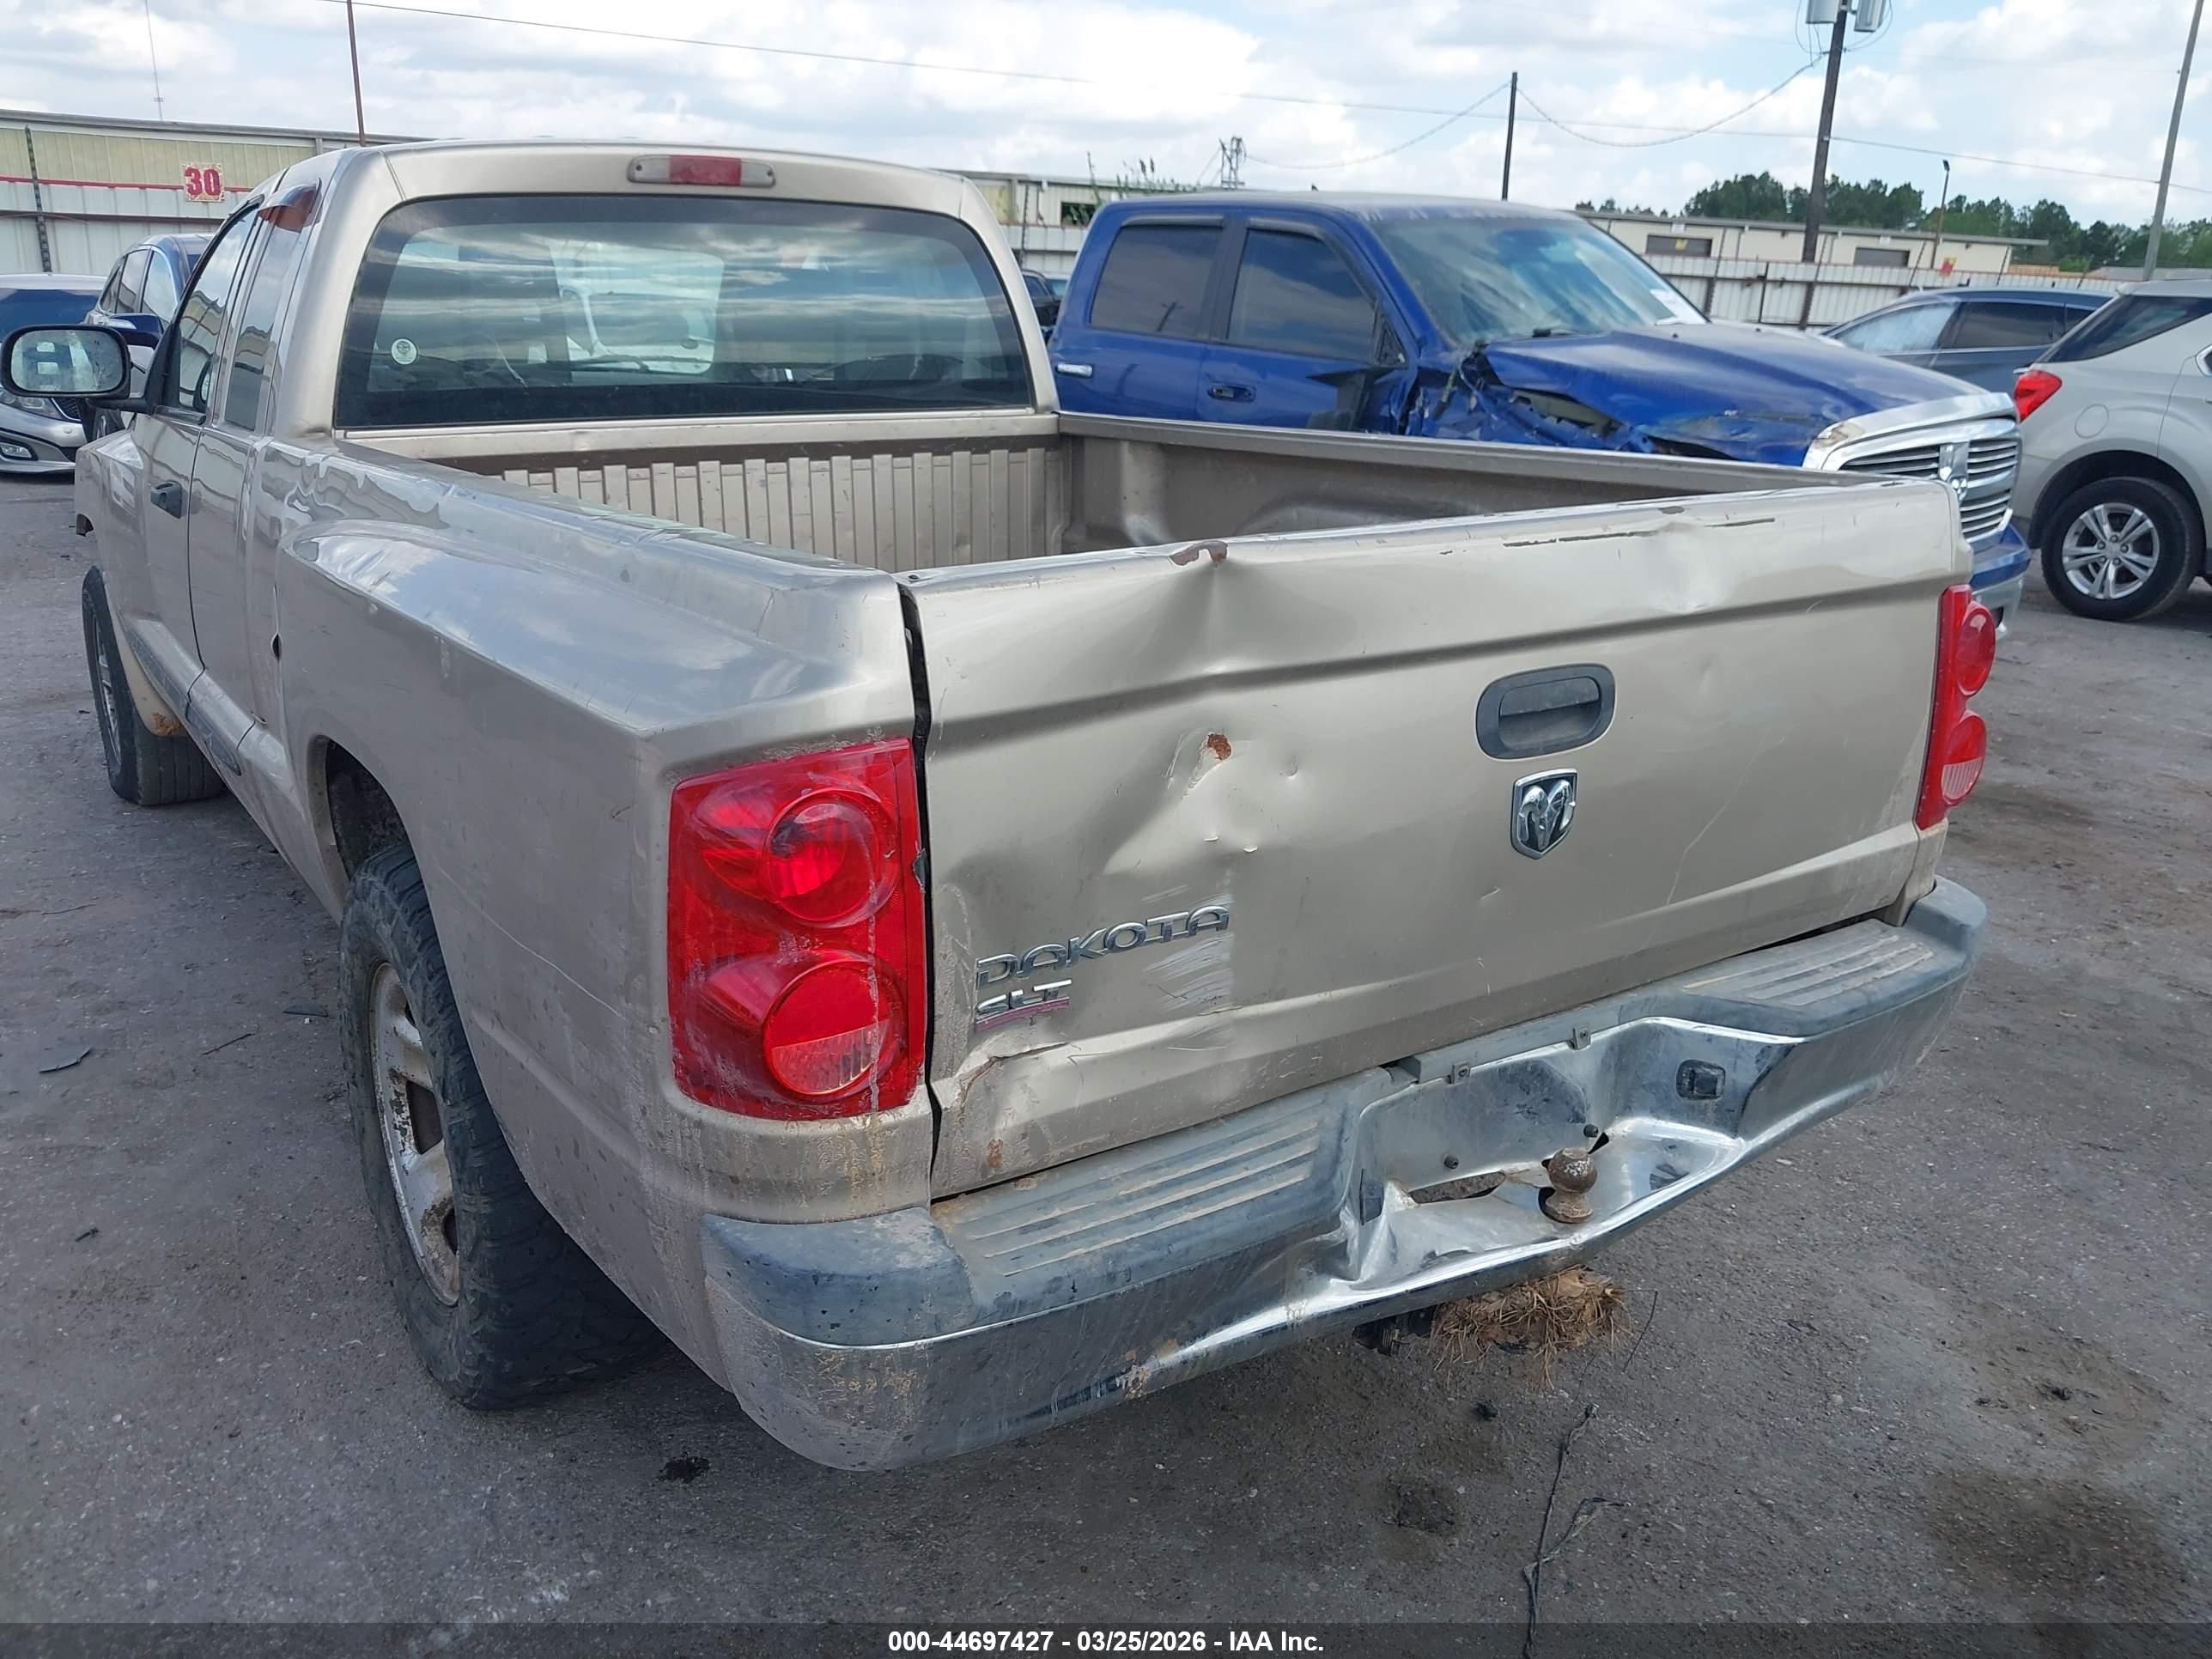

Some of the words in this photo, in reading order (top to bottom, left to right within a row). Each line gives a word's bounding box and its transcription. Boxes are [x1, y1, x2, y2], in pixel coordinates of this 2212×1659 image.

[185, 167, 221, 196] 30
[975, 905, 1230, 989] DAKOTA
[975, 979, 1072, 1022] SLT
